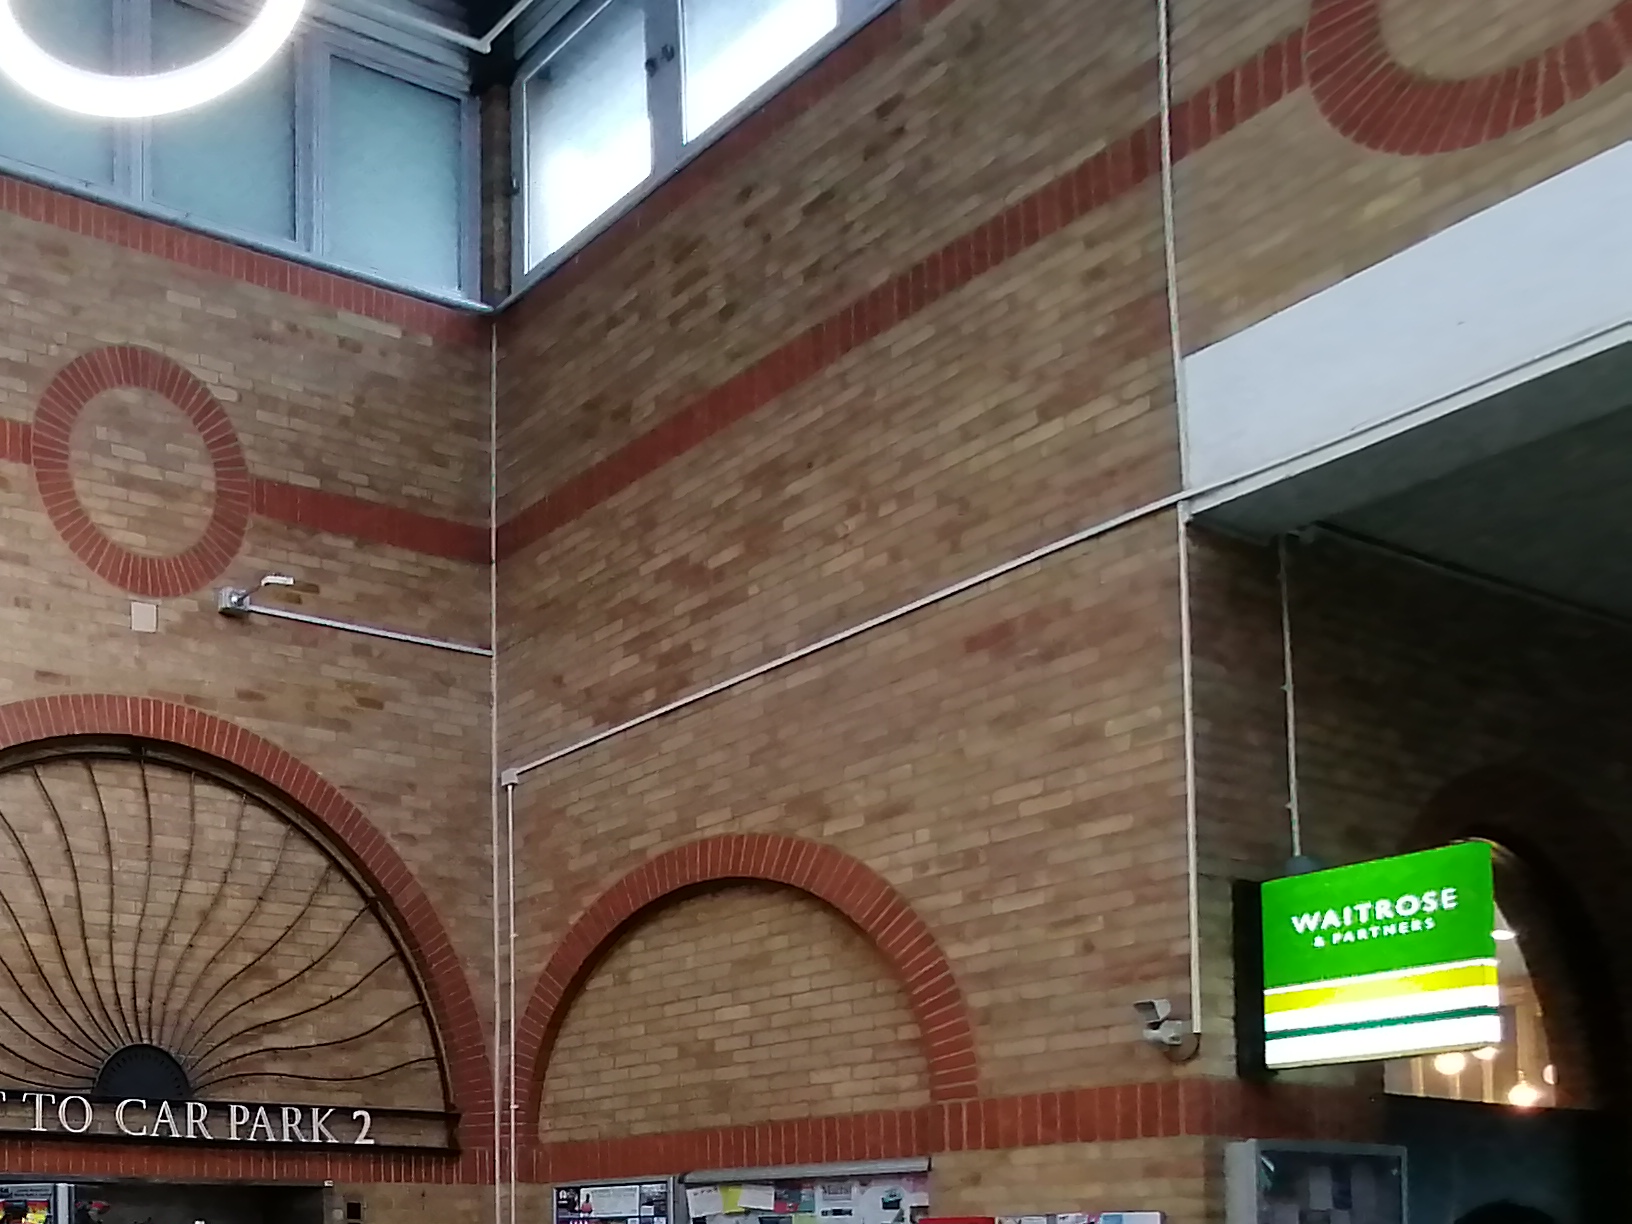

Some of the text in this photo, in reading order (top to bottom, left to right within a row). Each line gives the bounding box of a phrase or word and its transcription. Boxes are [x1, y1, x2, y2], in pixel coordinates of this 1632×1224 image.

[1291, 887, 1458, 934] WAITROSE
[1312, 917, 1435, 948] & PARTNERS
[22, 1092, 94, 1134] TO
[115, 1098, 214, 1141] CAR
[227, 1103, 341, 1144] PARK
[352, 1110, 376, 1146] 2
